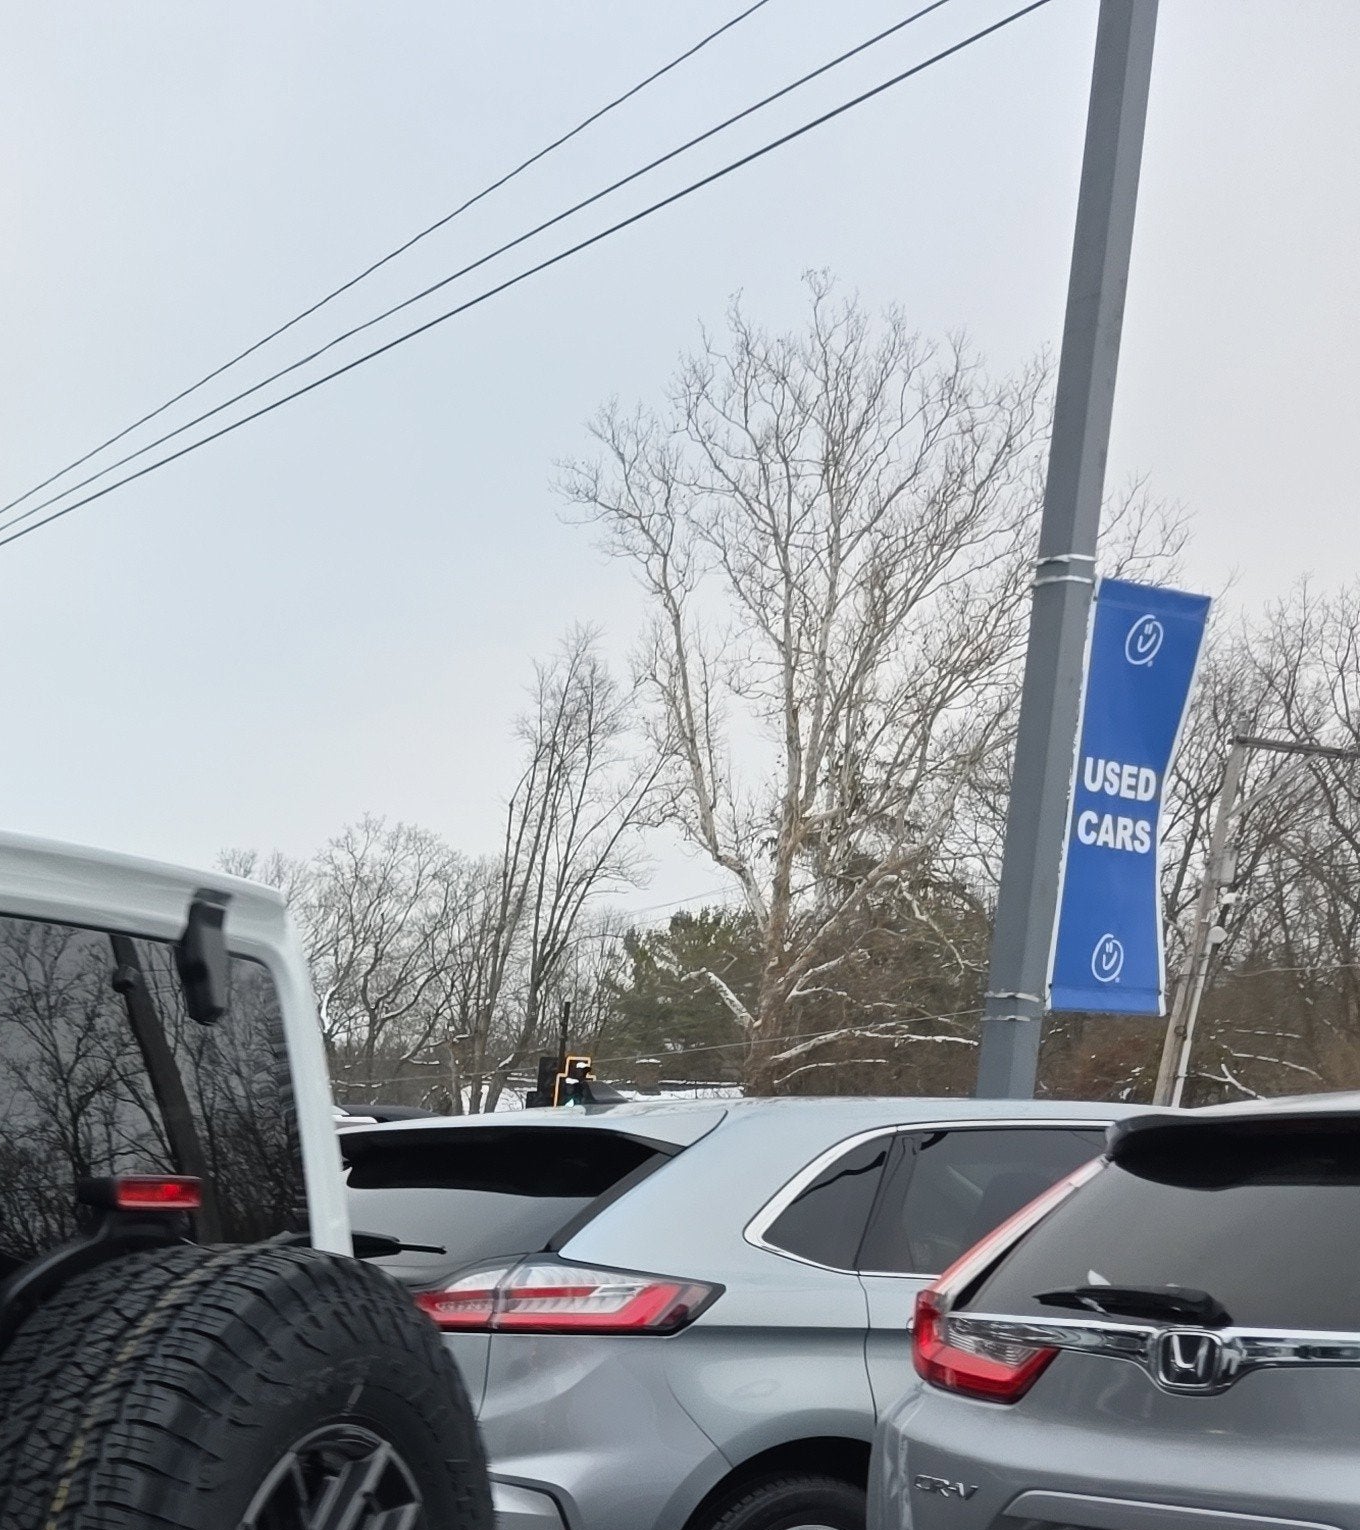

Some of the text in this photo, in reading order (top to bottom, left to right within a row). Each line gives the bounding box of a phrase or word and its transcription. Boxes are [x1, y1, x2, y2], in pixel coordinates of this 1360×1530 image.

[1084, 756, 1157, 802] USED
[1077, 810, 1151, 854] CARS
[914, 1474, 979, 1501] CR-V
